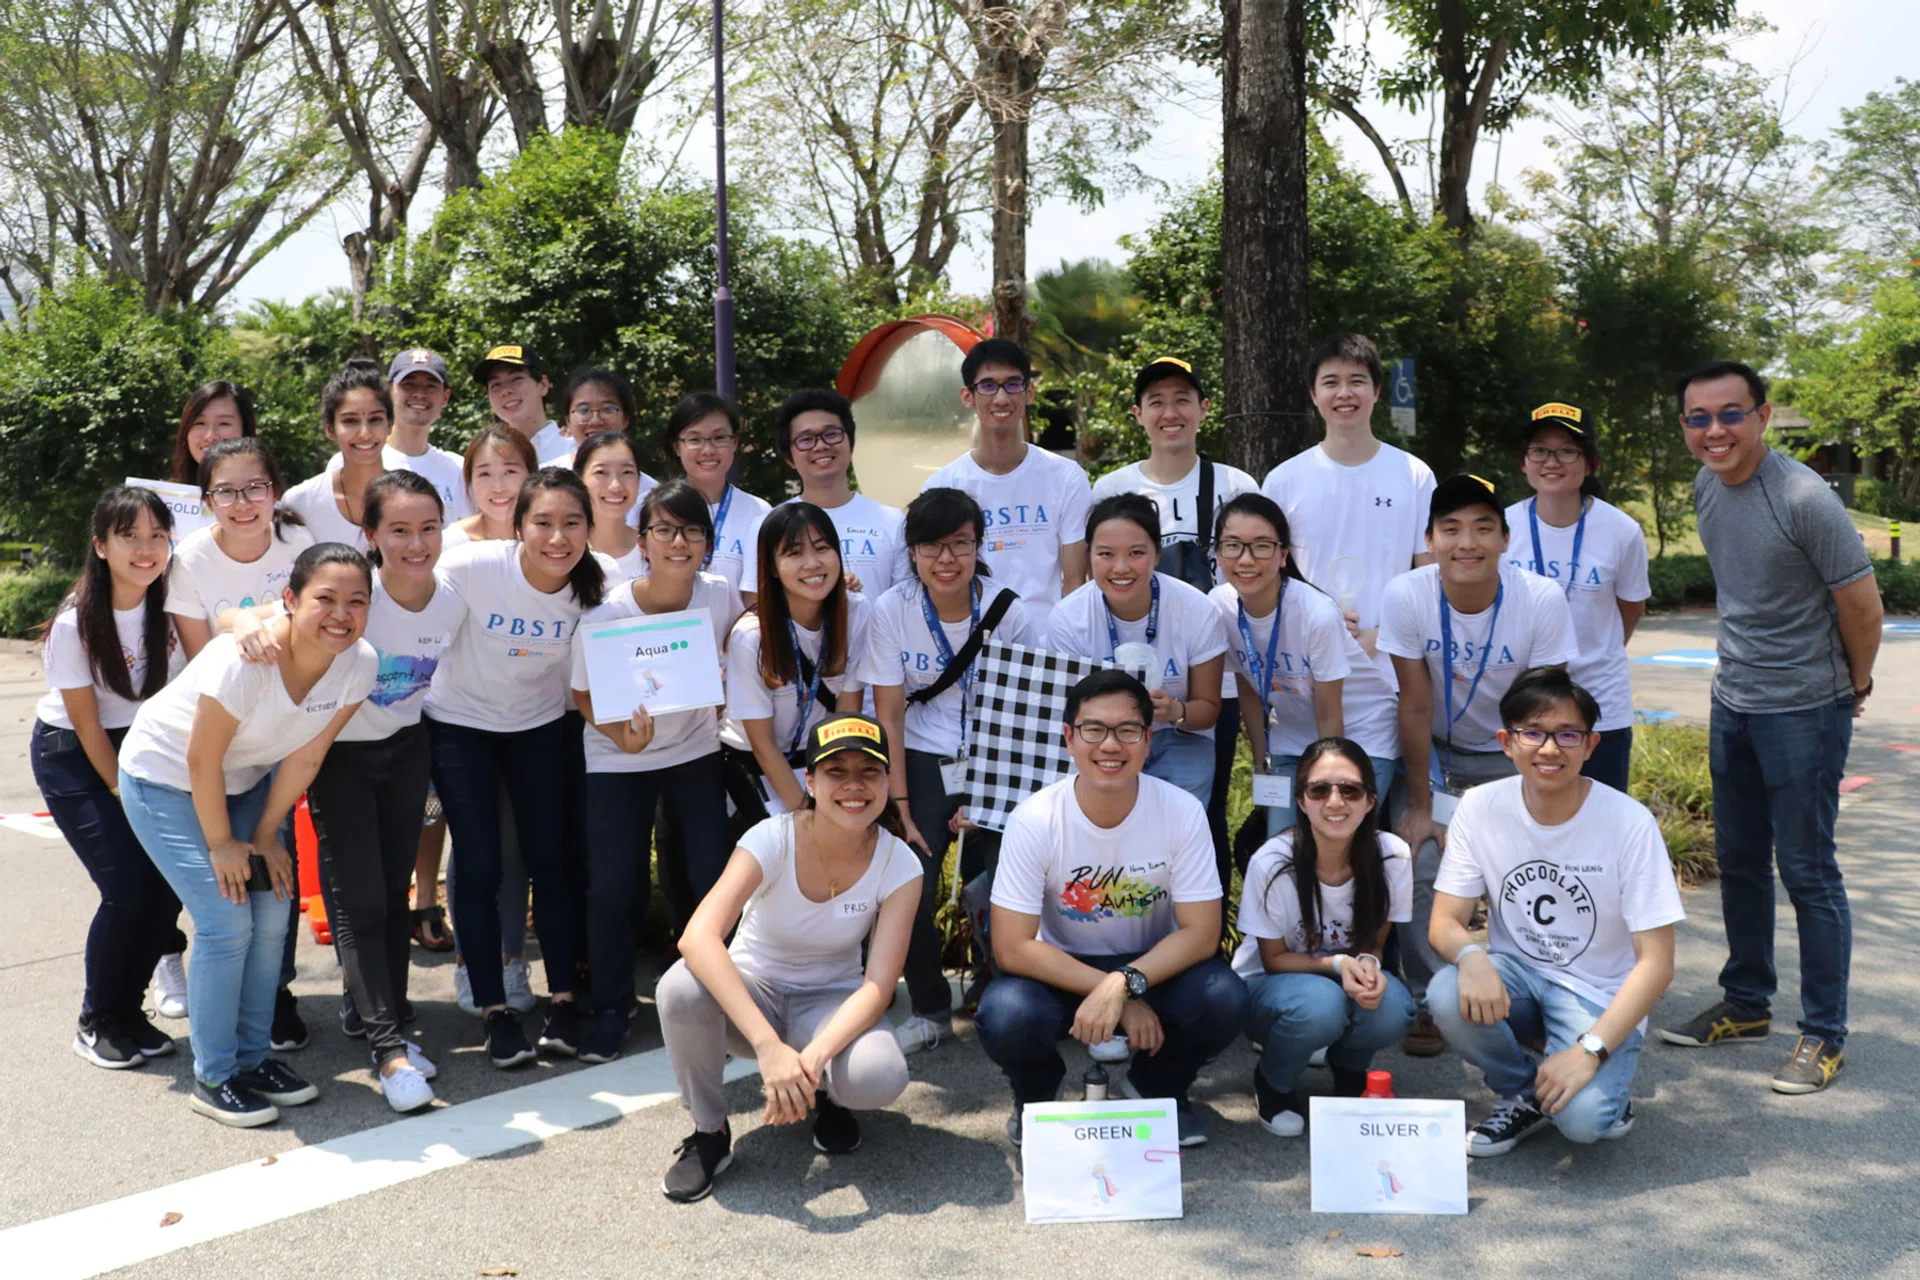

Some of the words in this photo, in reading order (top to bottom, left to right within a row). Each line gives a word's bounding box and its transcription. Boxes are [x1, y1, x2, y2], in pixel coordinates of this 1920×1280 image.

[165, 501, 200, 515] GOLD
[982, 504, 1048, 528] BSTA
[487, 613, 579, 638] PBST
[635, 644, 669, 658] Aqua
[823, 721, 877, 740] PIRELLI
[1066, 864, 1125, 891] RUN
[844, 902, 868, 914] PRIS
[1100, 888, 1168, 911] Autism
[1074, 1125, 1133, 1141] GREEN
[1360, 1122, 1420, 1137] SILVER
